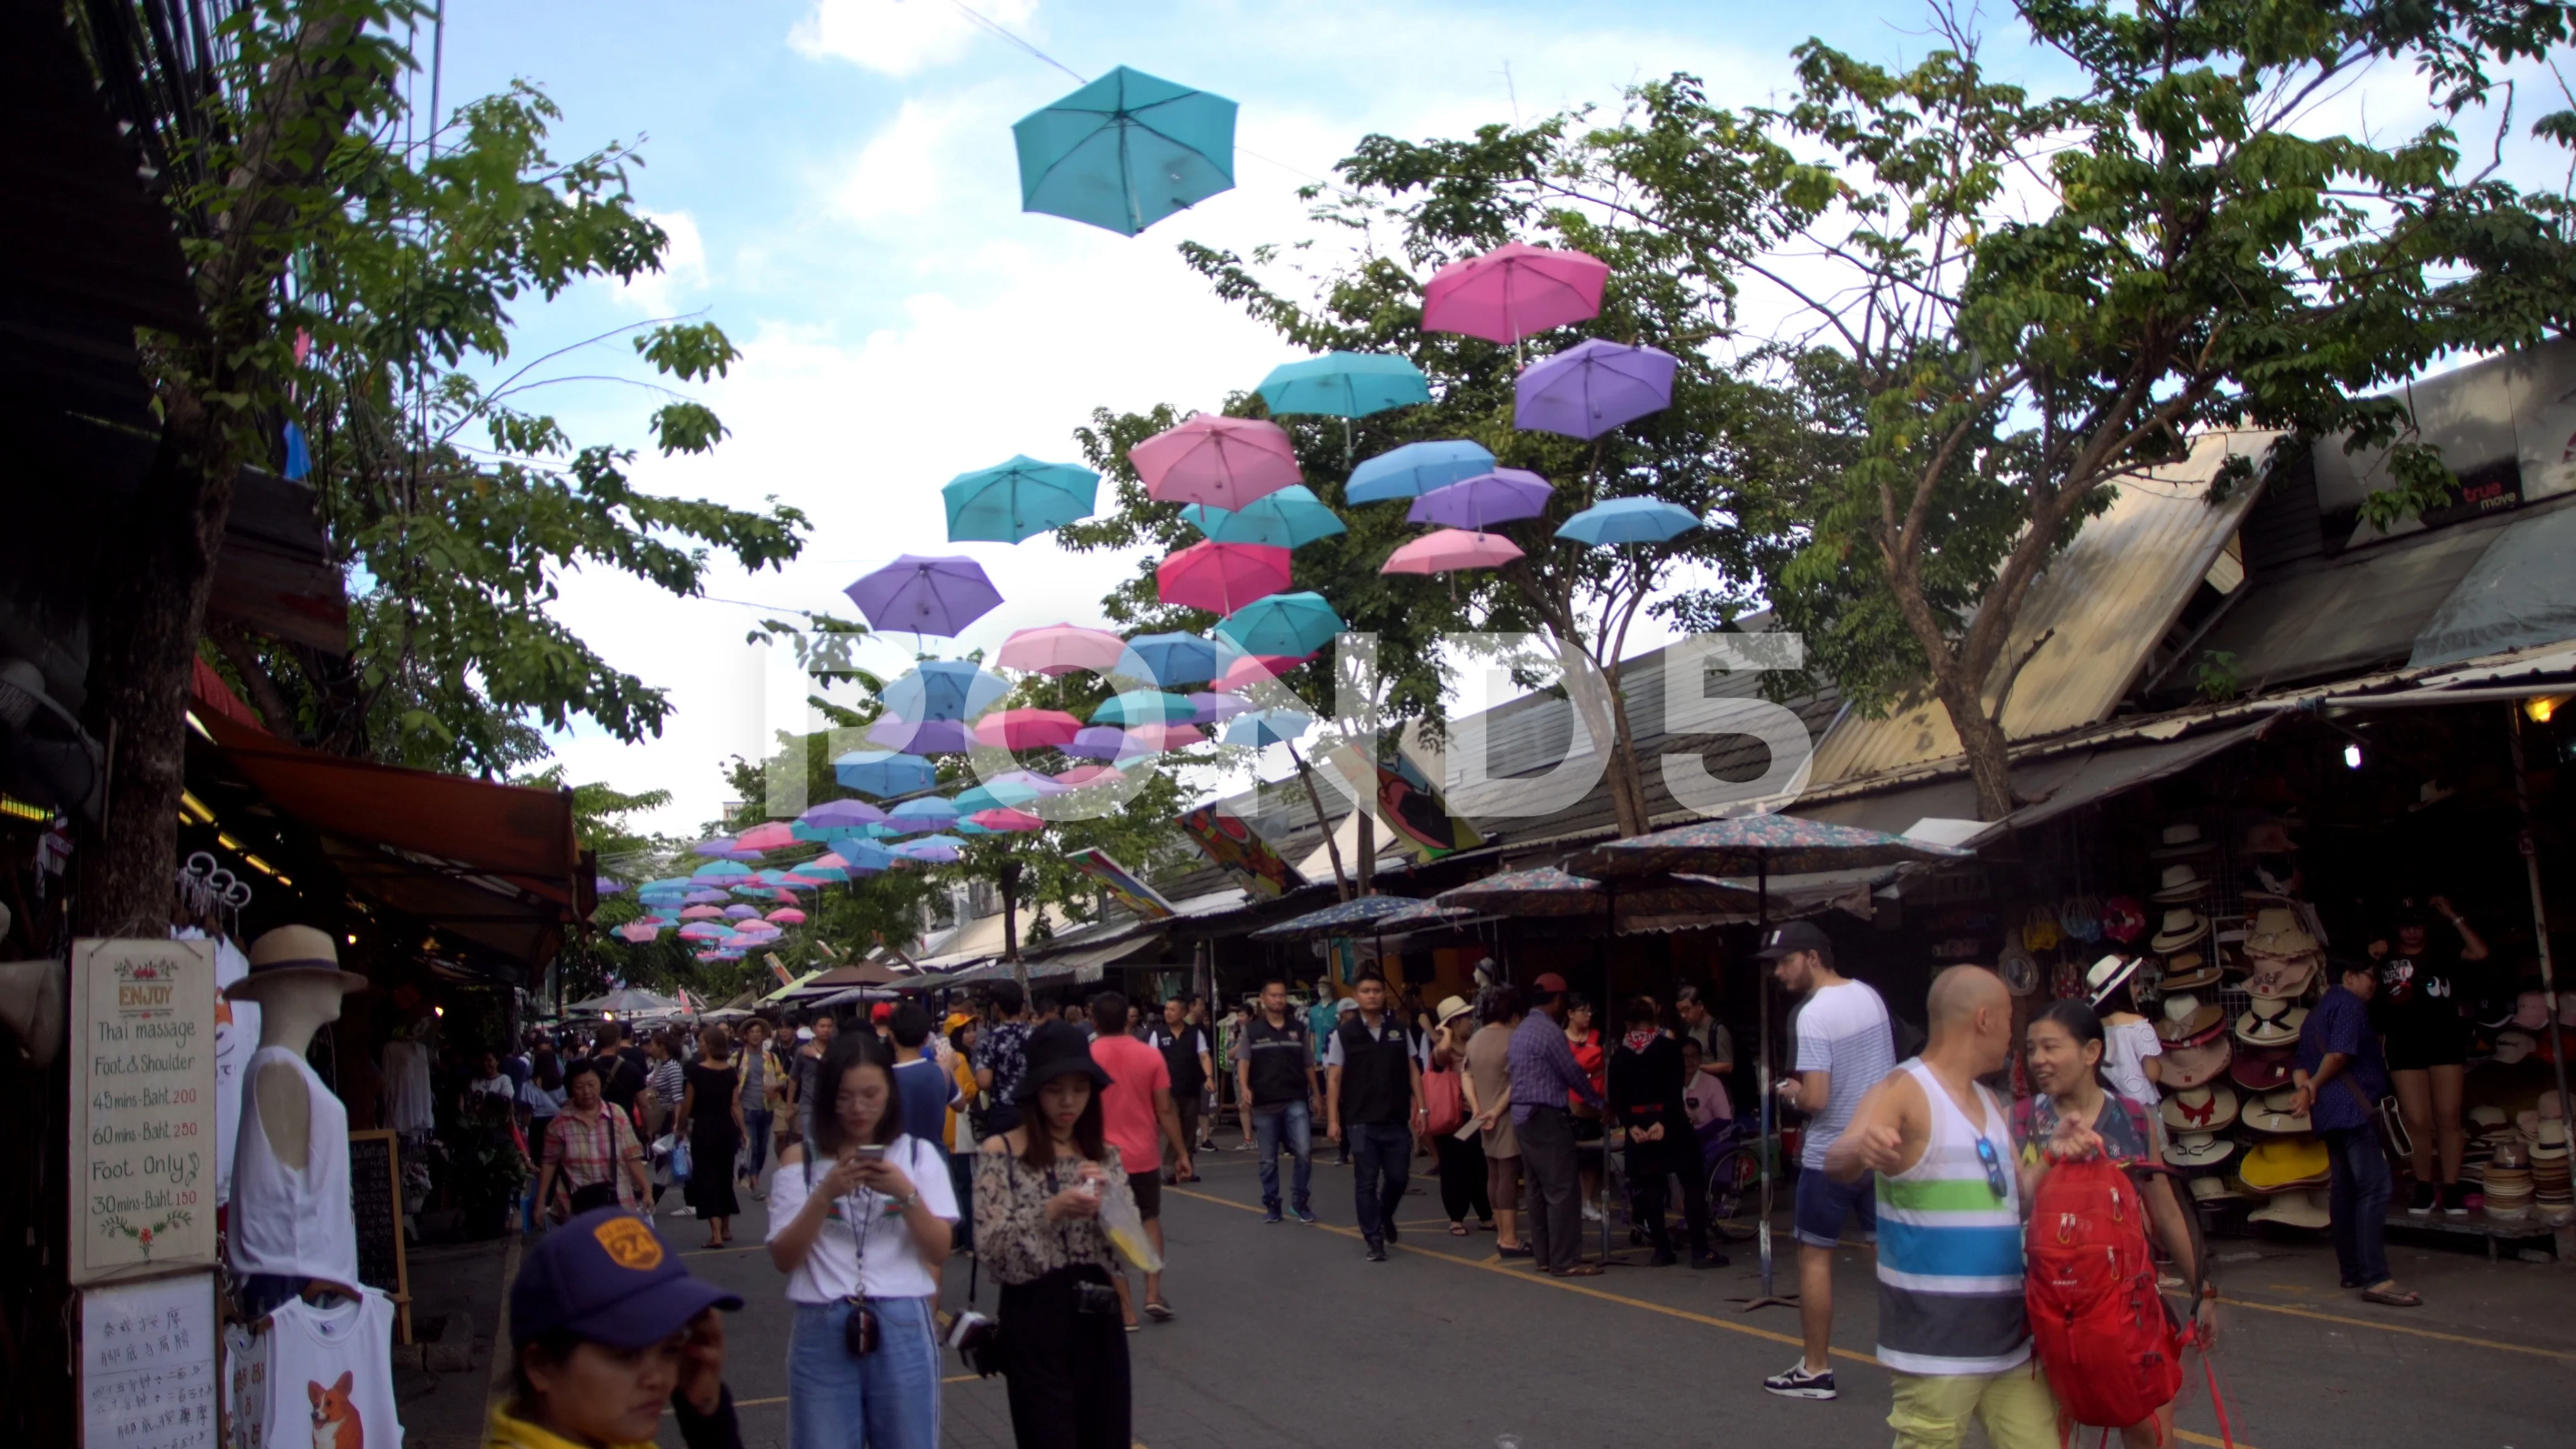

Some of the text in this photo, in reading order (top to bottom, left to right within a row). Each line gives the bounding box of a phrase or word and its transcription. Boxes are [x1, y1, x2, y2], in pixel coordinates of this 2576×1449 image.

[2463, 482, 2501, 503] true
[2480, 492, 2516, 509] move
[119, 985, 173, 1006] ENJOY
[97, 1021, 196, 1048] Thai massage
[95, 1055, 125, 1076] Foot
[126, 1055, 139, 1074] &
[142, 1052, 195, 1073] Shoulder
[173, 1088, 196, 1104] 200
[174, 1122, 197, 1138] 250
[92, 1154, 184, 1184] Foot Only
[176, 1191, 196, 1206] 150
